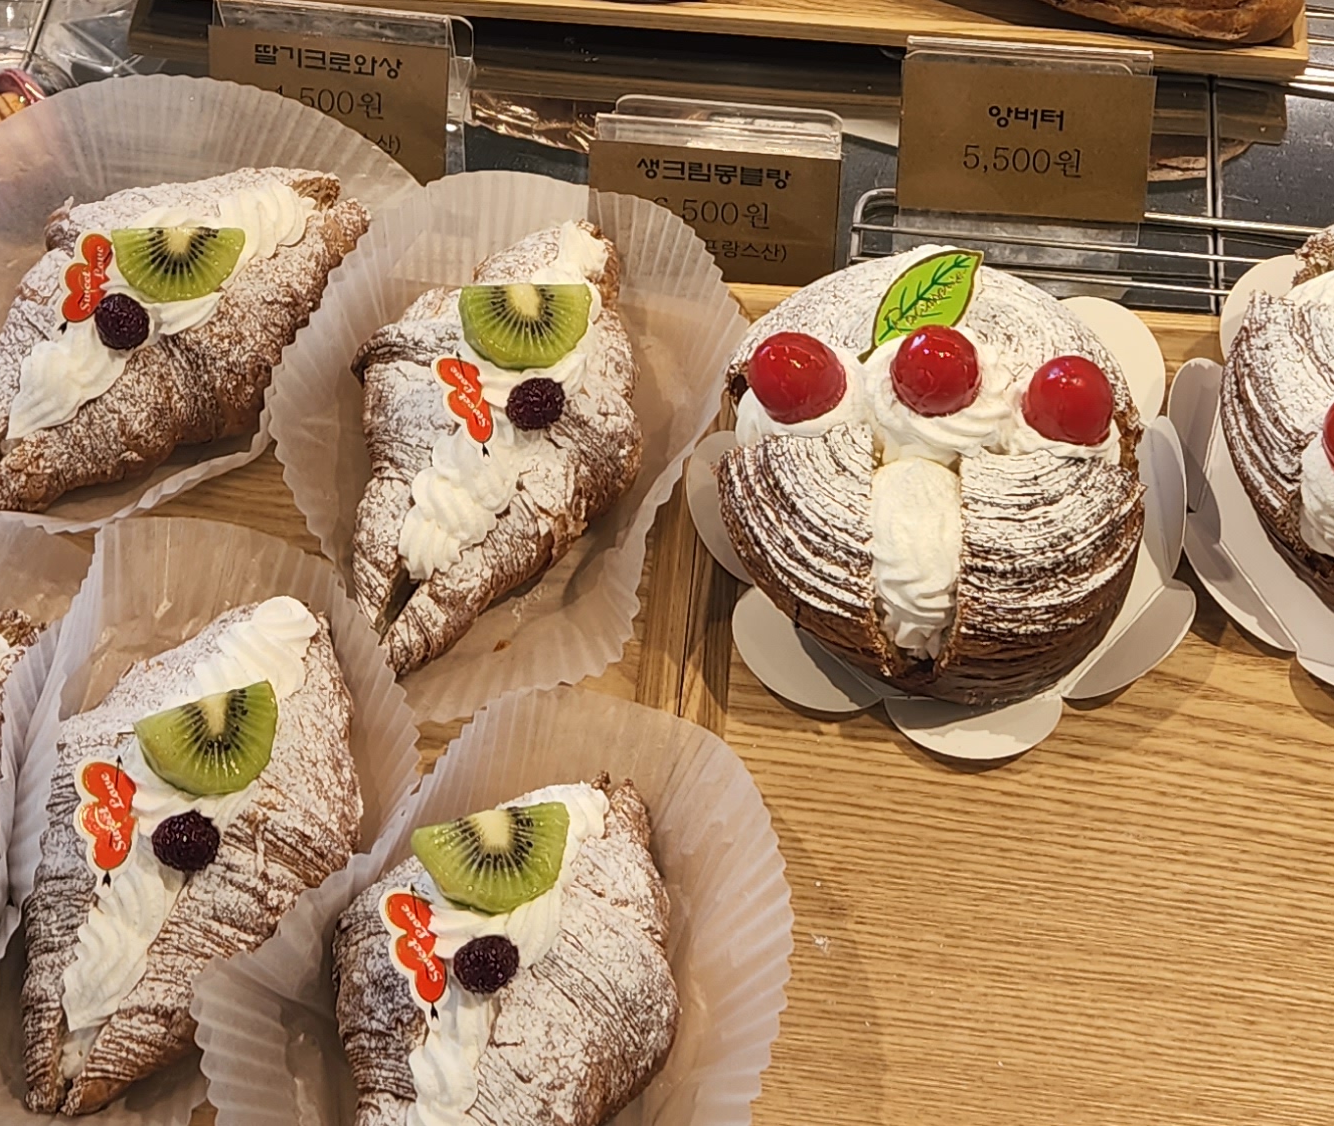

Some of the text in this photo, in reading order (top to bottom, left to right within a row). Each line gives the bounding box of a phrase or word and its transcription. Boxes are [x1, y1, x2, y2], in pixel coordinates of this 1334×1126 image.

[254, 44, 403, 79] 딸기크로와상
[988, 105, 1064, 132] 앙버터
[637, 158, 791, 190] 생크림몽블랑
[963, 144, 1081, 179] 5,500원
